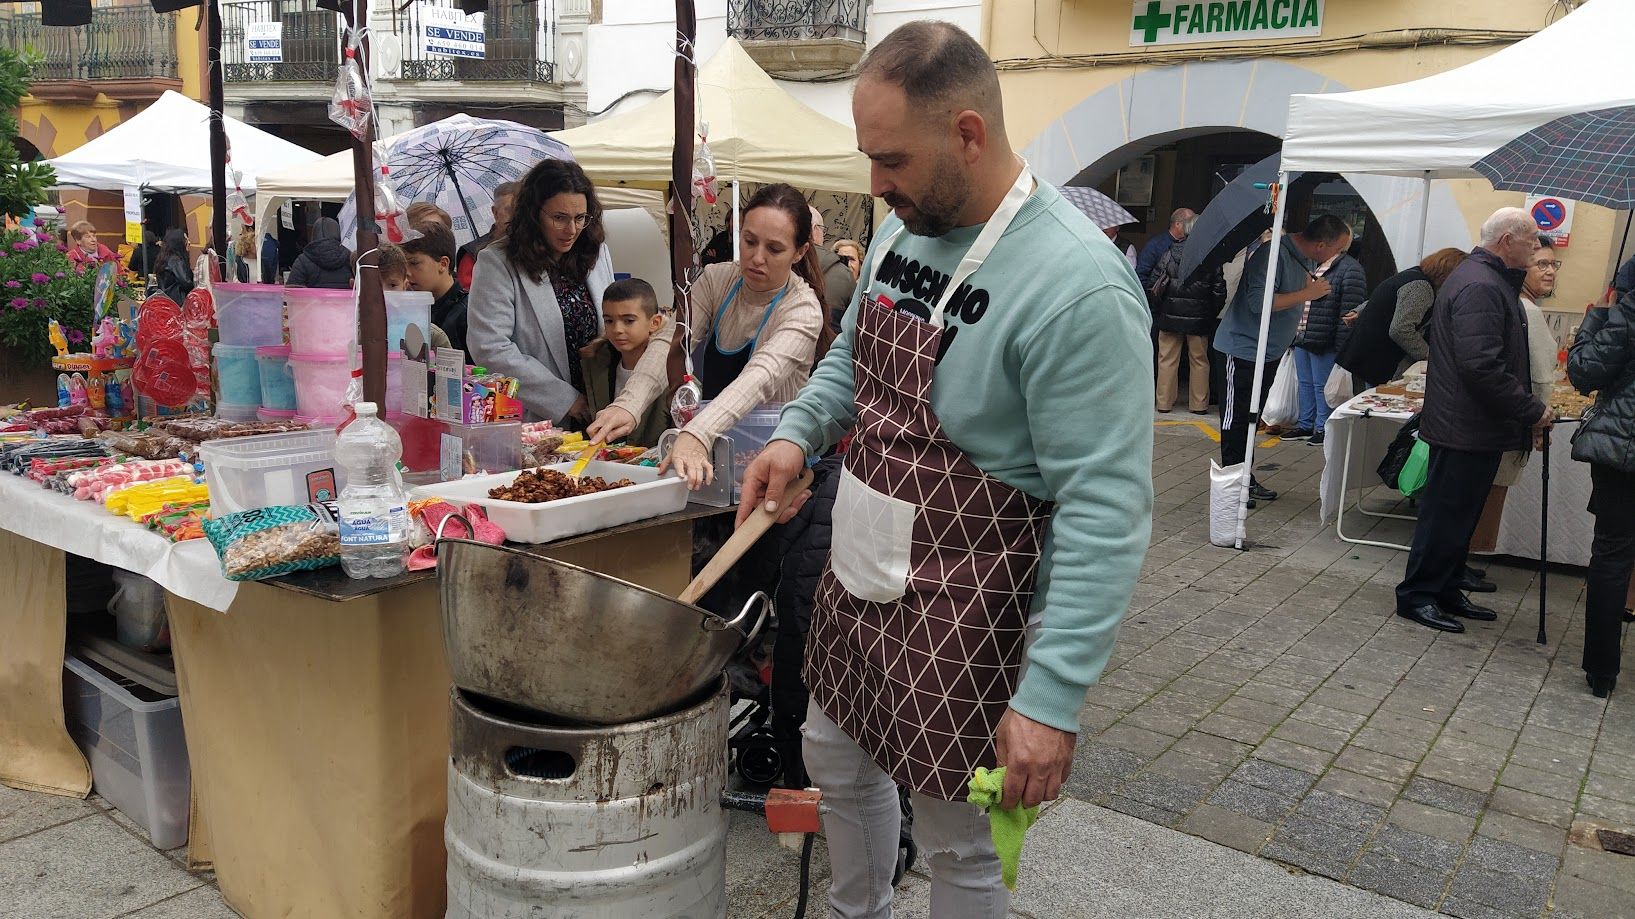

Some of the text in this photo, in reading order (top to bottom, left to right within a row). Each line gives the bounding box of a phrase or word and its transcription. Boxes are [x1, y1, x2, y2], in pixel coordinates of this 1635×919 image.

[431, 8, 477, 23] HABITEX
[1173, 0, 1319, 35] FARMACIA
[427, 27, 483, 42] SE VENDE
[249, 40, 280, 48] SE VENDE
